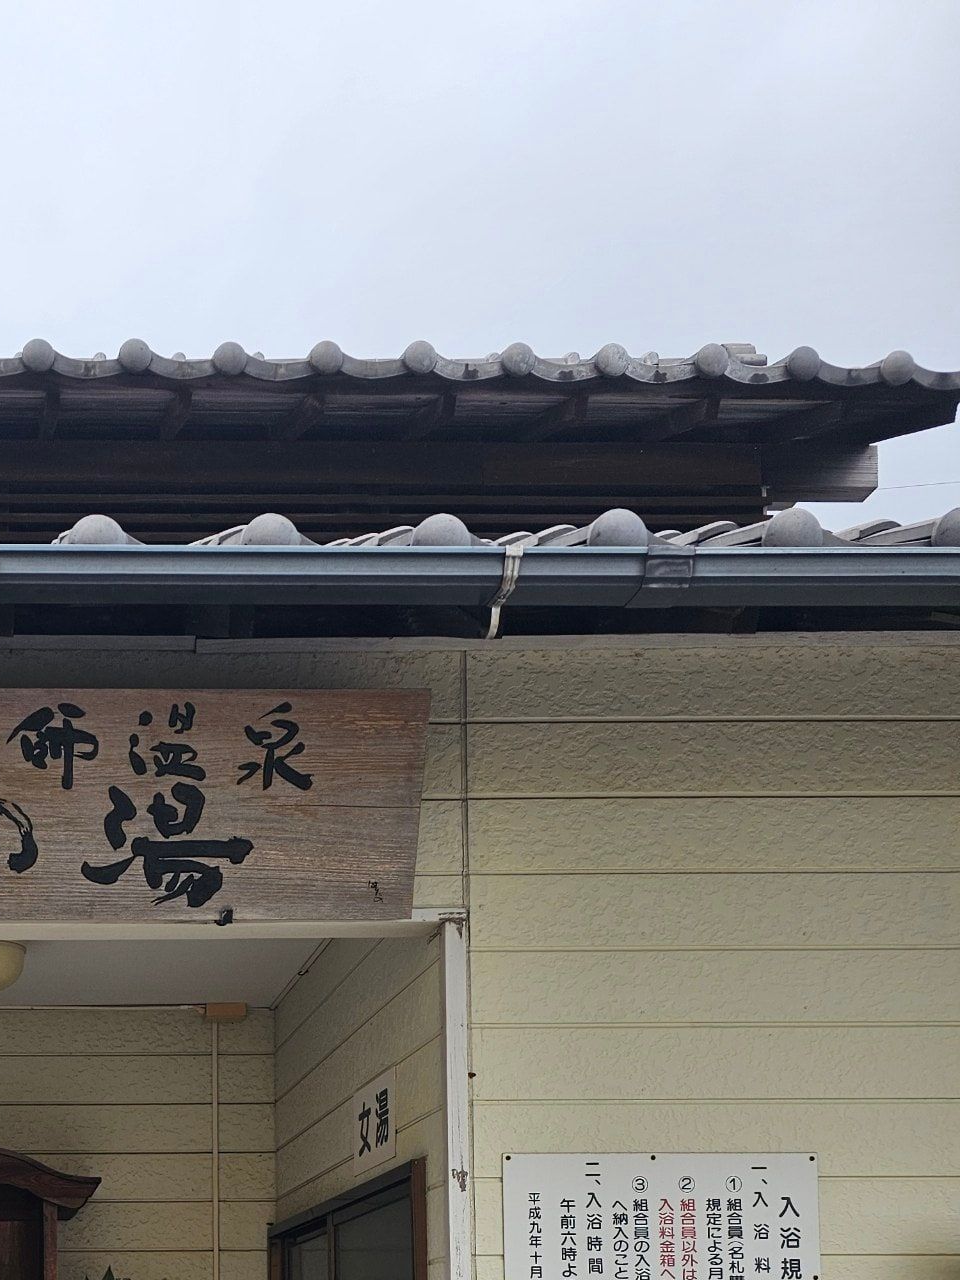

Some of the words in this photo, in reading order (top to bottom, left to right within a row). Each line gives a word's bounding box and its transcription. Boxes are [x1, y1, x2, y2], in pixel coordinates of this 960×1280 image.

[357, 1088, 390, 1158] 女湯
[584, 1162, 604, 1274] 二、入浴時間
